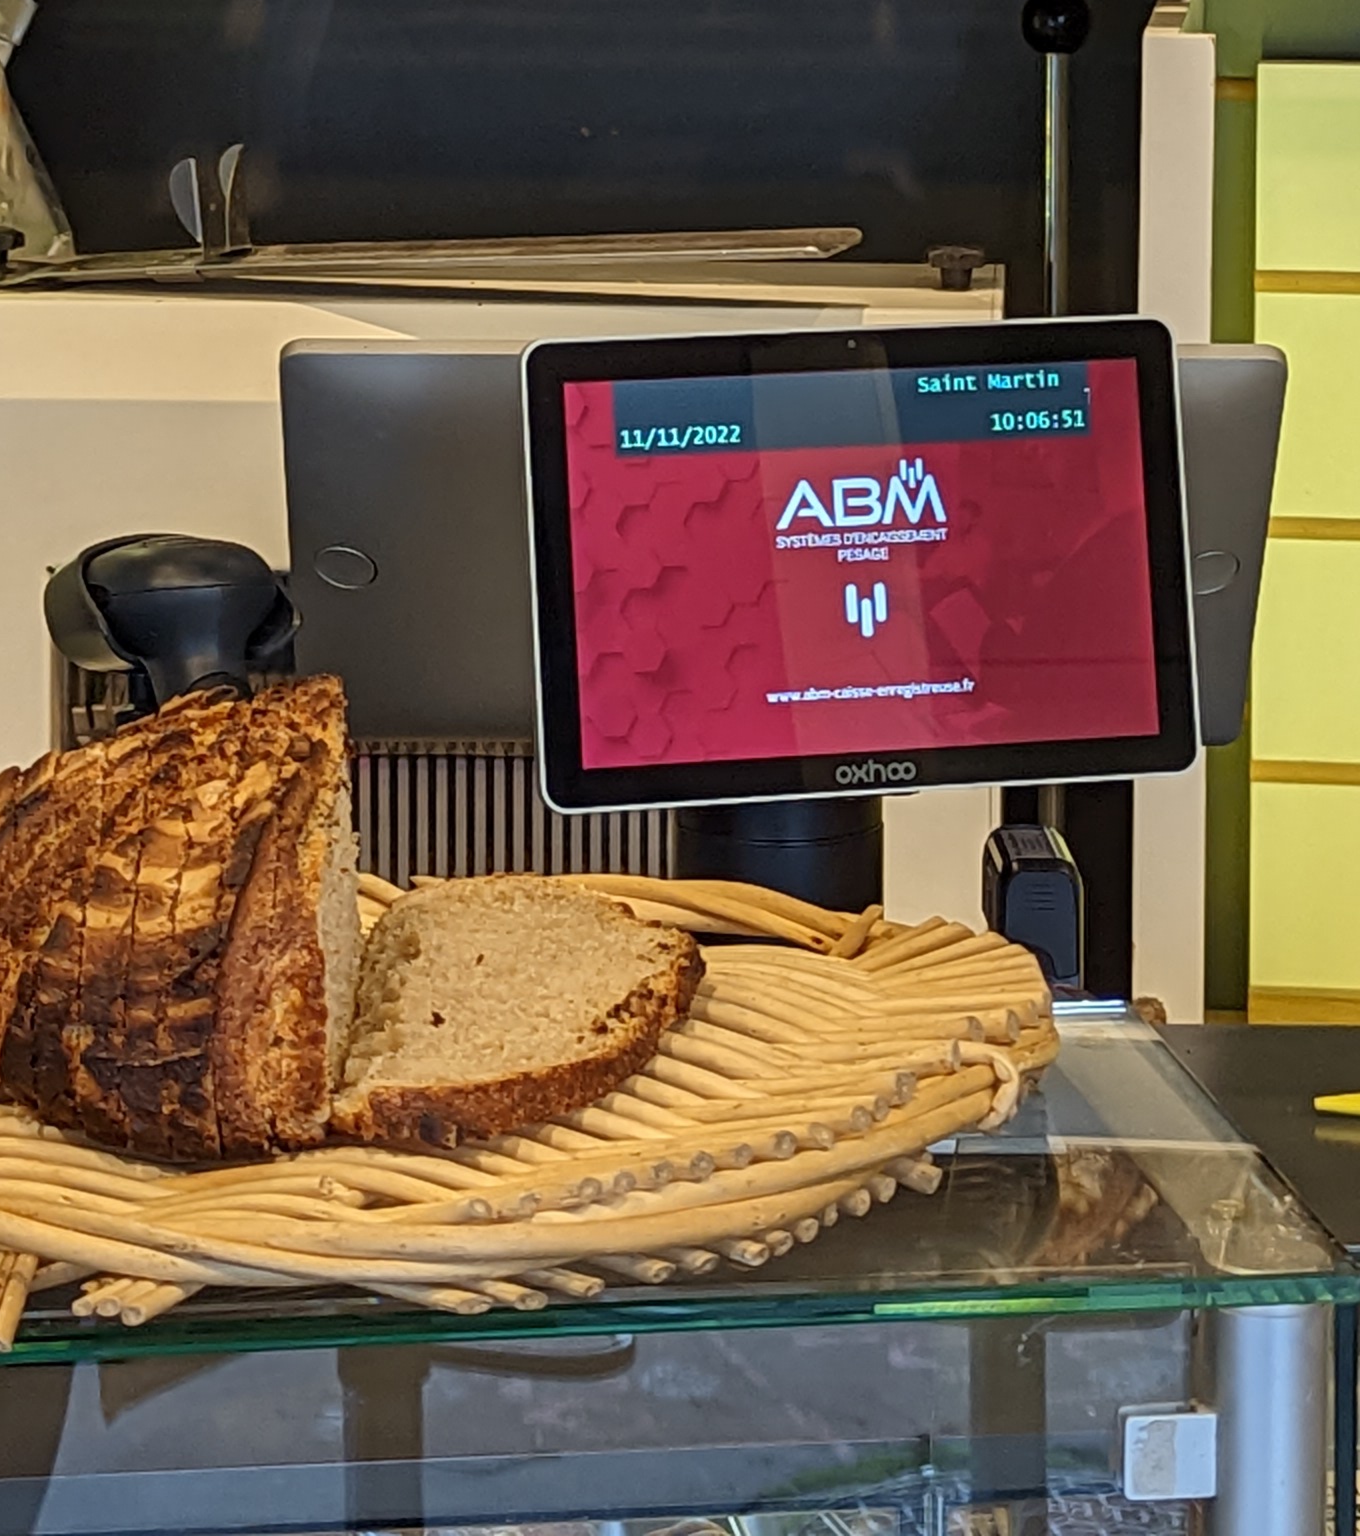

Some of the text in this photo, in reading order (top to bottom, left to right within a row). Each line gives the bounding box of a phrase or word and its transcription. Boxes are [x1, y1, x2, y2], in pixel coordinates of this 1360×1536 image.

[917, 368, 1060, 394] Saint Martin
[990, 409, 1086, 433] 10:06:51
[619, 424, 741, 450] 11/11/2022
[776, 473, 947, 530] ABM
[837, 546, 889, 563] PESAGE
[835, 759, 917, 785] oxhoo
